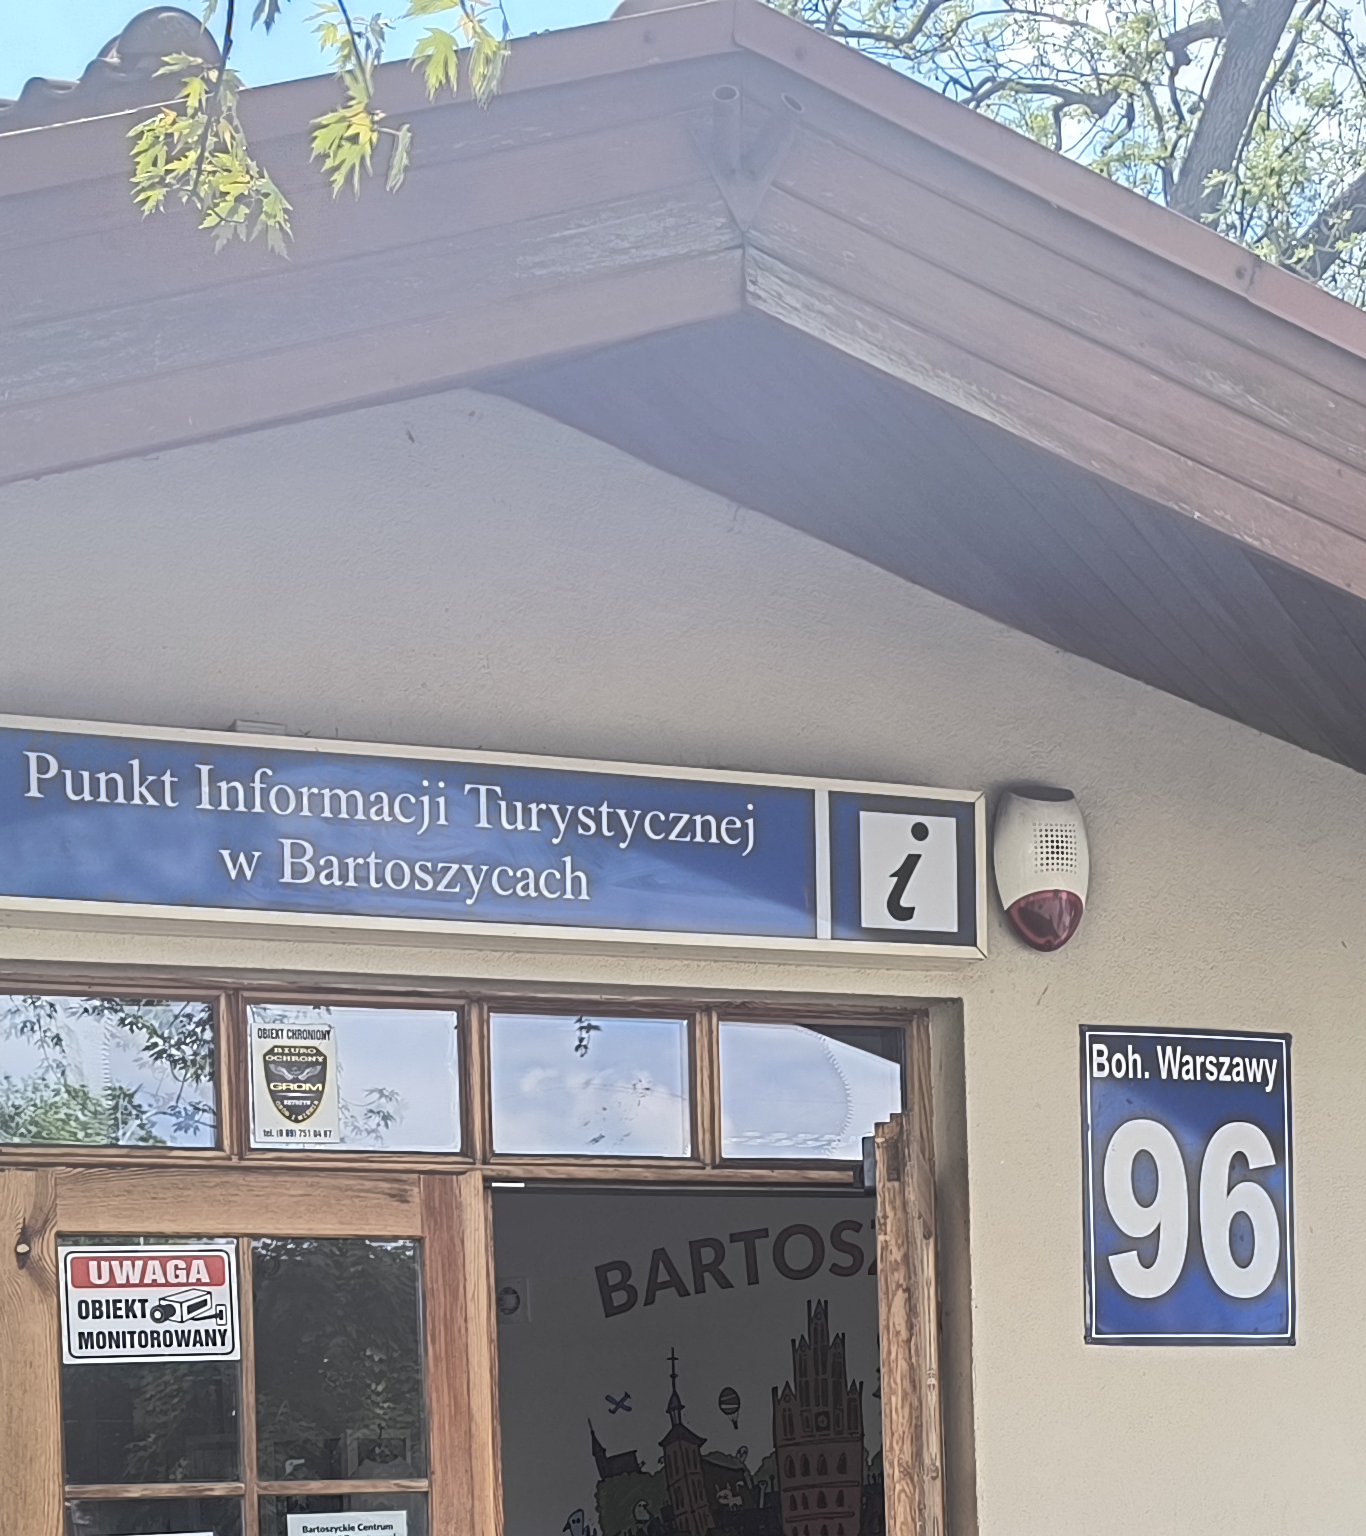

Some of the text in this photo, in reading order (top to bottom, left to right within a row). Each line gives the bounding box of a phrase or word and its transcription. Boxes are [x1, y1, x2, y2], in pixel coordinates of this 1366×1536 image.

[23, 751, 756, 856] Punkt Informacji Turystycznej
[219, 838, 591, 904] w Bartoszycach
[885, 822, 929, 921] i
[257, 1028, 331, 1041] OBIEKT CHRONIONY
[270, 1083, 322, 1091] GROM
[1092, 1043, 1277, 1093] Boh. Warszawy
[1103, 1118, 1280, 1299] 96
[88, 1259, 210, 1286] UWAGA
[595, 1218, 877, 1318] BARTOS
[77, 1299, 149, 1321] OBIEKT
[77, 1329, 228, 1351] MONITOROWANY
[302, 1523, 393, 1534] Bartoszyckie Centrum
